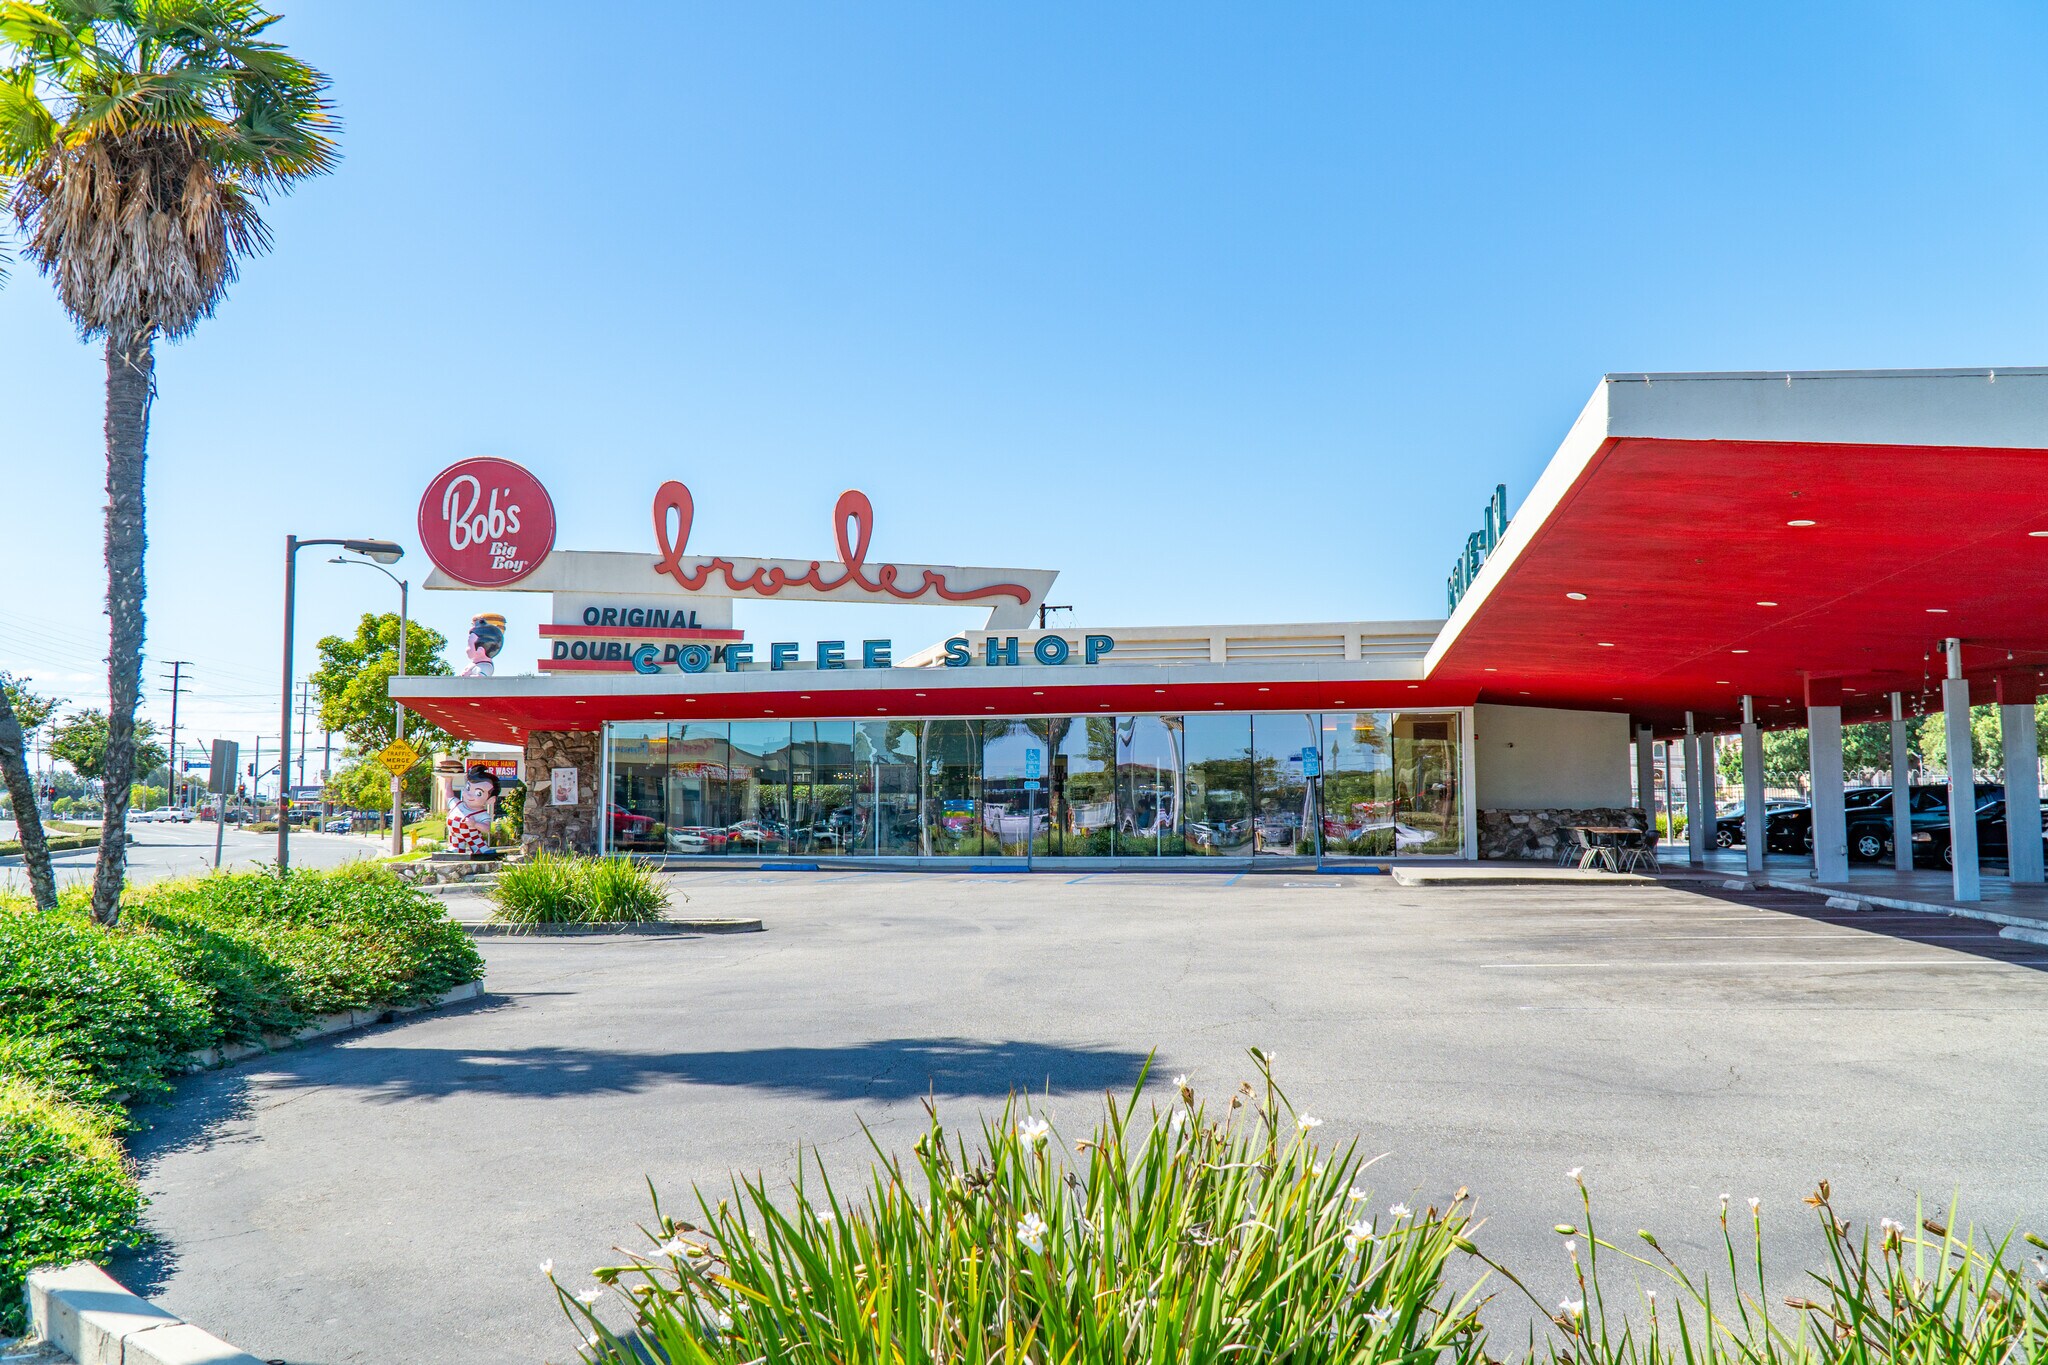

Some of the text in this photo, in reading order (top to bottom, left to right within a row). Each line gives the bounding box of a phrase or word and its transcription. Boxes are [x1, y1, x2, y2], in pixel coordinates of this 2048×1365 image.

[442, 474, 521, 551] Bob's
[488, 541, 518, 559] Big
[652, 479, 1032, 606] broiler
[582, 606, 703, 630] ORIGINAL
[631, 634, 1115, 675] COFFEE SHOP
[495, 767, 516, 776] WASH
